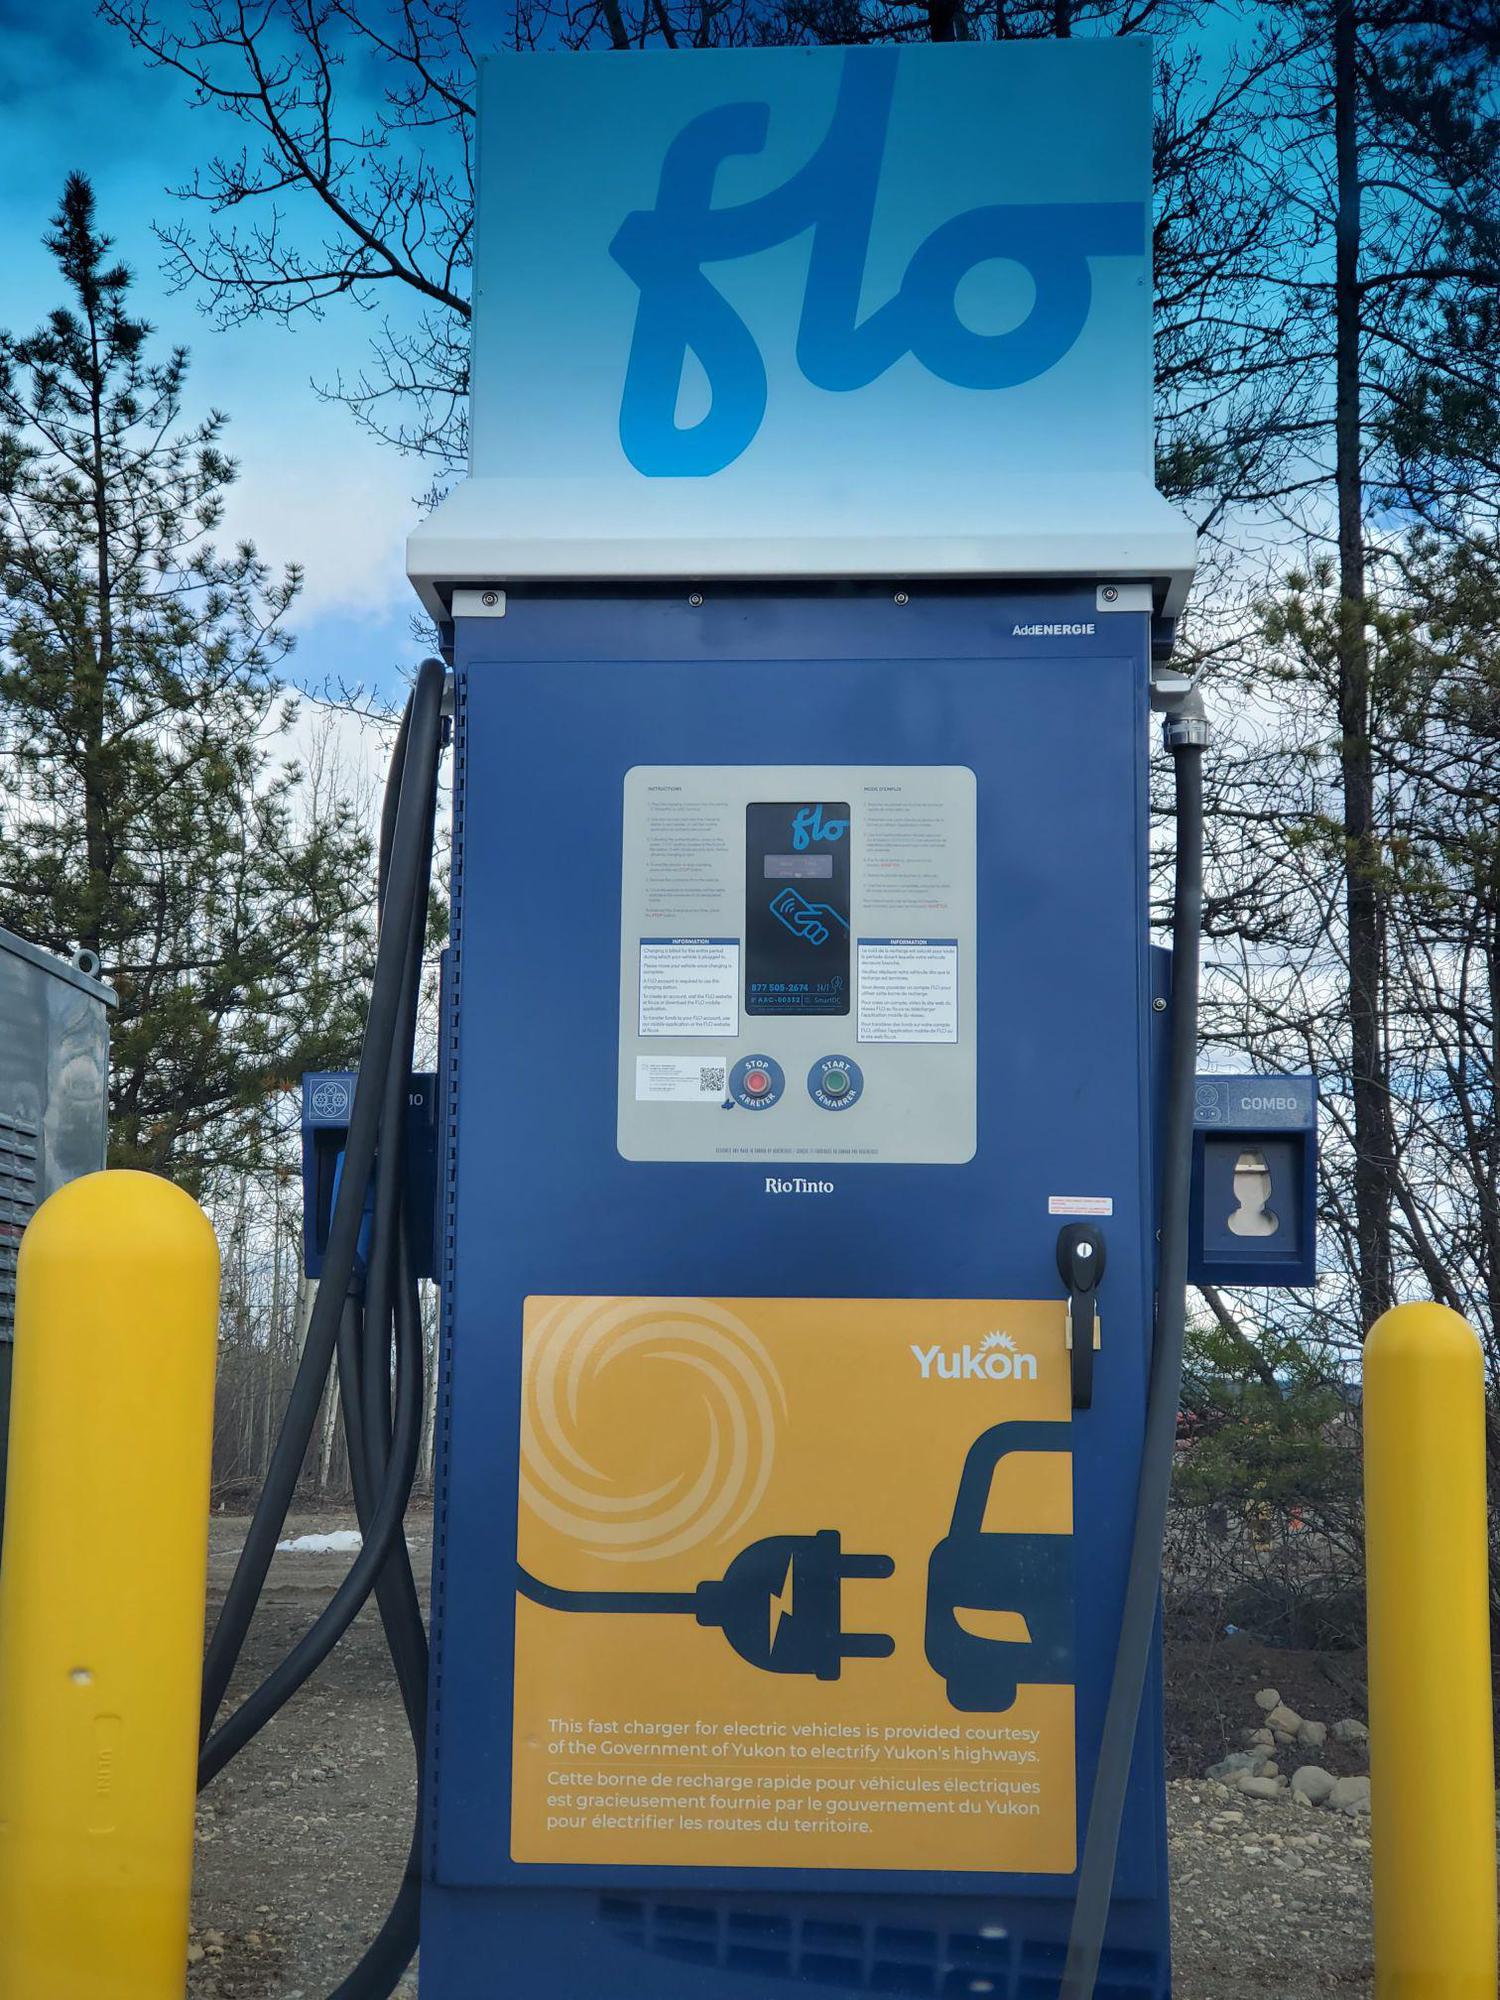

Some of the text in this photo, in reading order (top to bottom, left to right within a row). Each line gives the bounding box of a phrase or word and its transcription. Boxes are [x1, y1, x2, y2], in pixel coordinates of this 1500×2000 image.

[609, 48, 1145, 477] flo
[792, 802, 849, 850] flo
[745, 1060, 768, 1069] STOP
[821, 1060, 850, 1071] START
[1241, 1097, 1297, 1110] COMBO
[910, 1344, 1037, 1380] Yukon
[548, 1718, 1040, 1743] This fast charger for electric vehicles is provided courtesy
[548, 1740, 1041, 1765] of the Government of Yukon to electrify Yukon's highways.
[547, 1771, 1041, 1796] Cette borne de recharge rapide pour véhicules électriques
[547, 1794, 1040, 1816] est gracieusement fournie par le gouvernement du Yukon
[546, 1813, 873, 1833] pour électrifier les routes du territoire.
